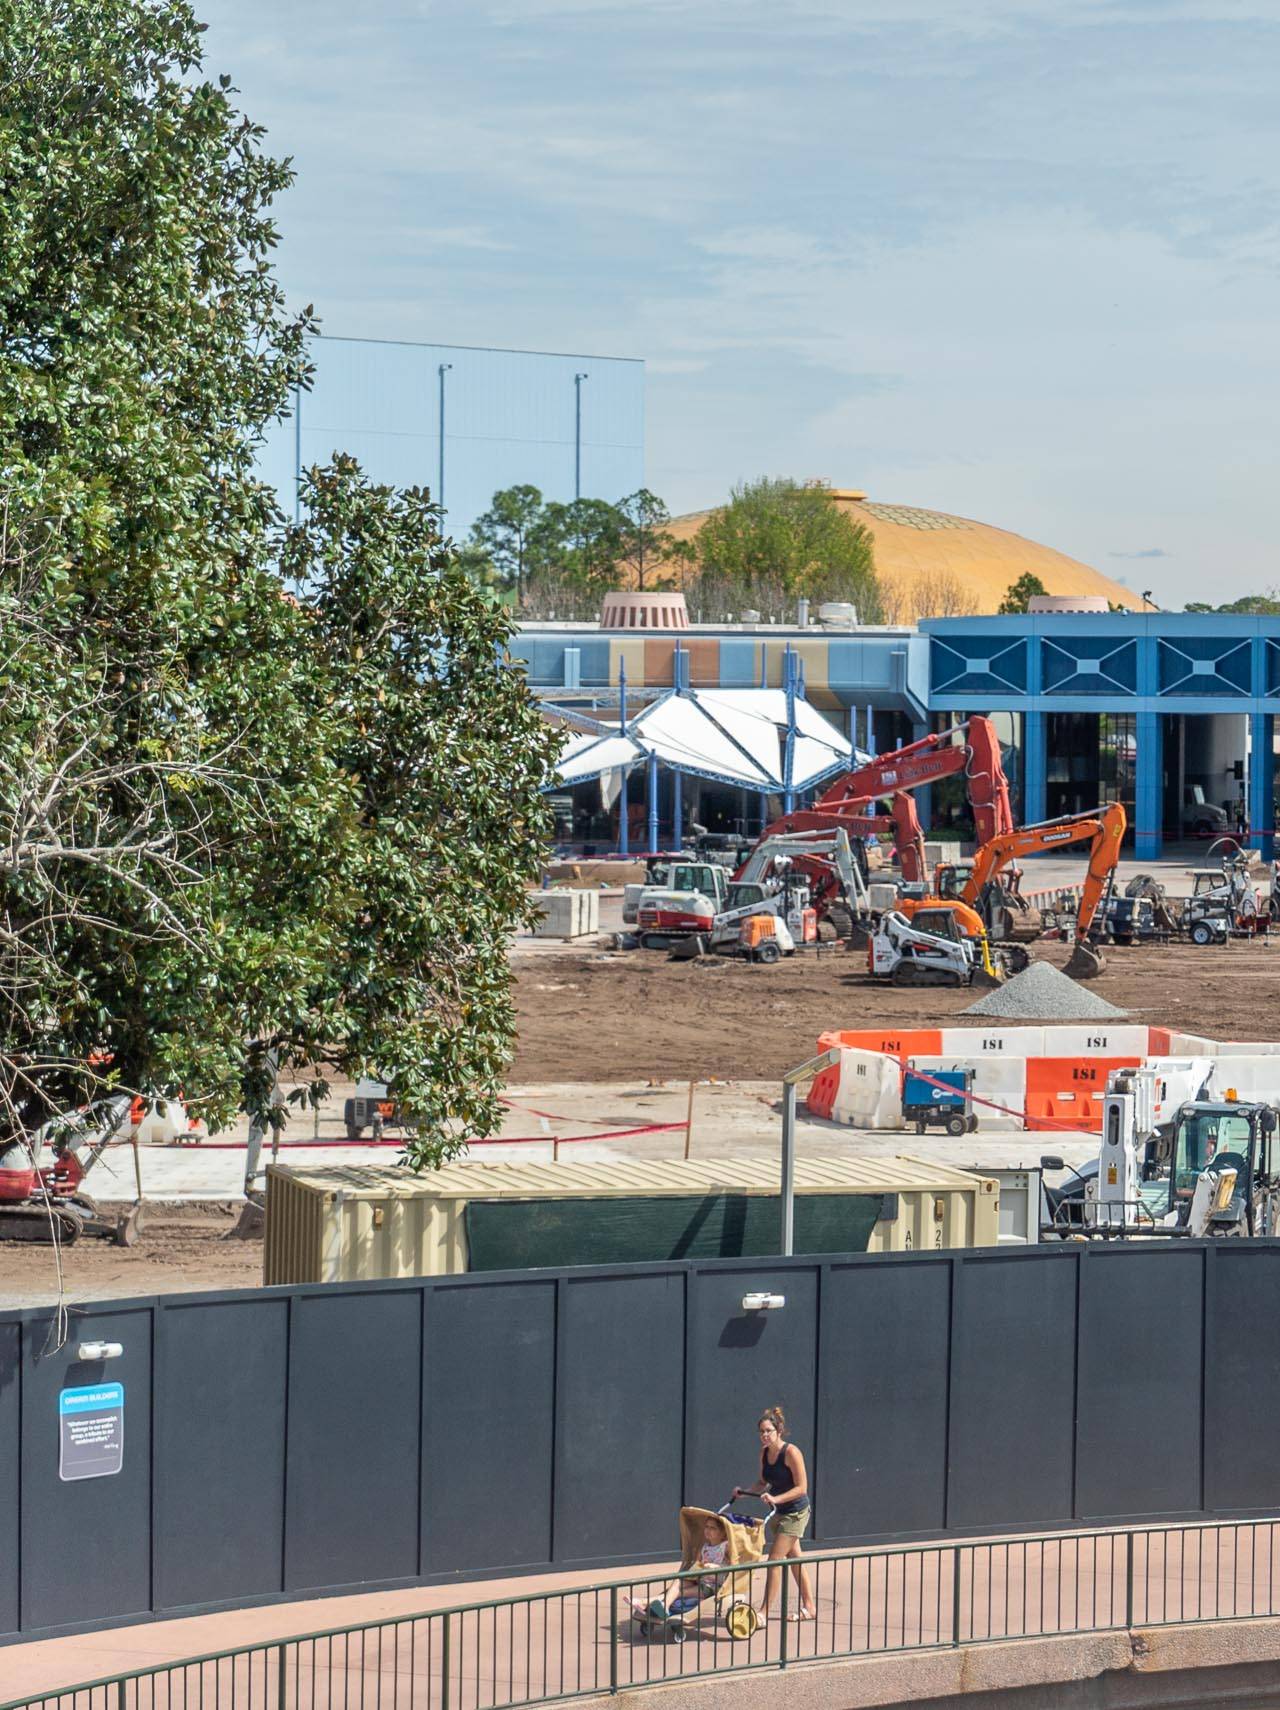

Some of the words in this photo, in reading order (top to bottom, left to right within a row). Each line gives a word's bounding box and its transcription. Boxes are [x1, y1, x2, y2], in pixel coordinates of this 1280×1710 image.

[881, 1040, 901, 1052] ISI
[982, 1039, 1003, 1050] ISI
[1086, 1037, 1108, 1048] ISI
[1072, 1068, 1097, 1080] ISI
